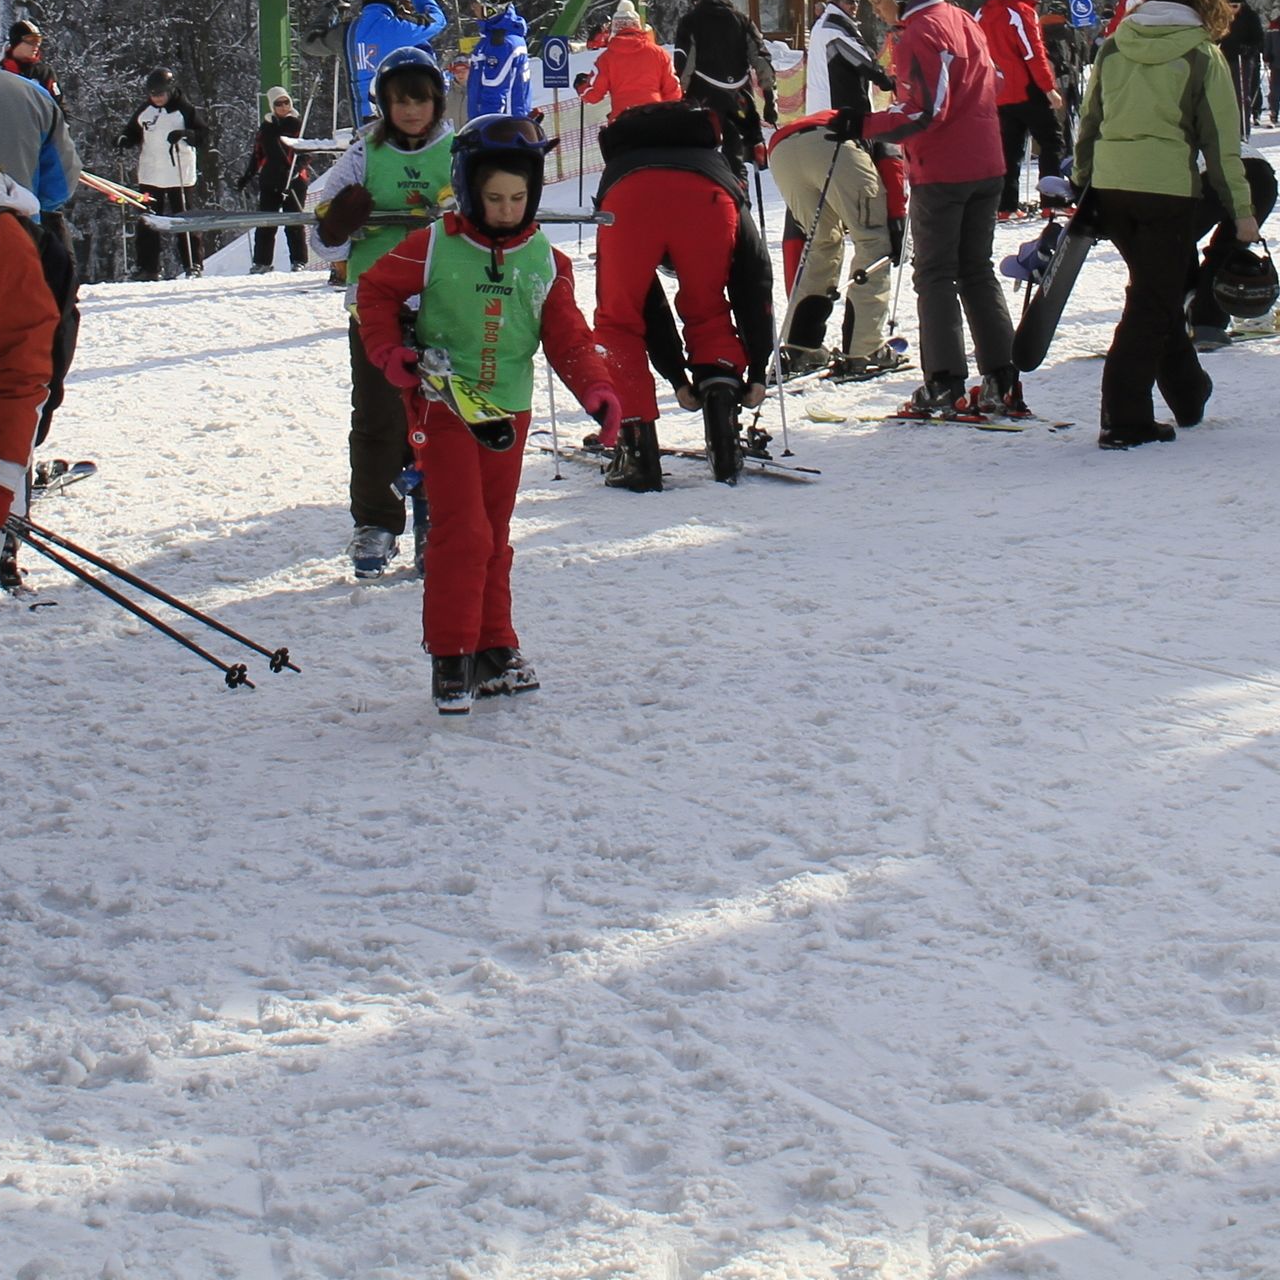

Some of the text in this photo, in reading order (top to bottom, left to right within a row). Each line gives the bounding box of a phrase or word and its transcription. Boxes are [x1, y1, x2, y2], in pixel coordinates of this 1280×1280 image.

[397, 180, 431, 190] virma
[475, 283, 514, 297] virma
[452, 379, 503, 418] FISCHE
